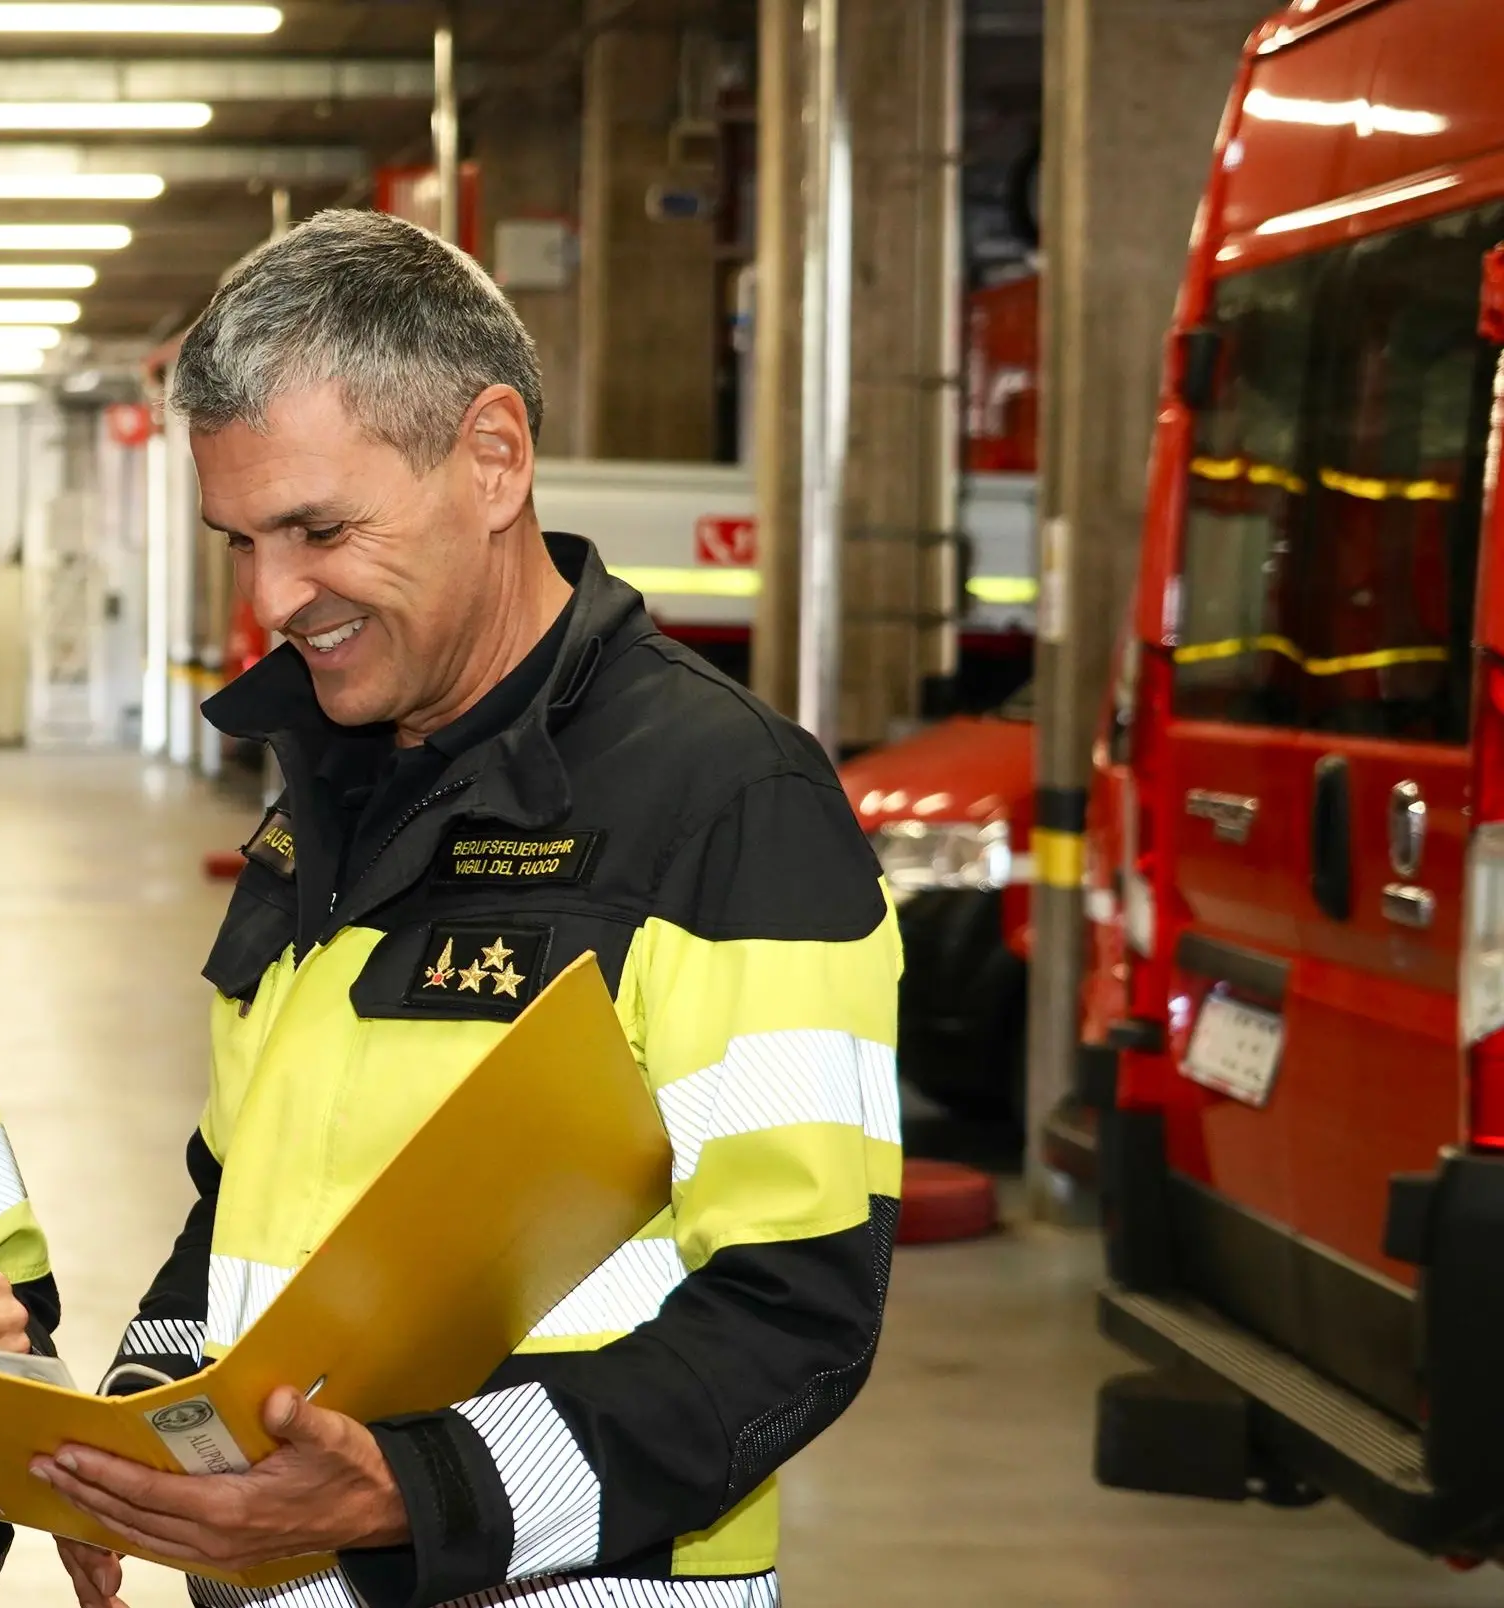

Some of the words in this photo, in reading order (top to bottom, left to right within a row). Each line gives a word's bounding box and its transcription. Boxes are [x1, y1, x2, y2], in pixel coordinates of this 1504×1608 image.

[452, 839, 574, 856] BERUFSFEUERWEHR
[456, 860, 487, 875] VIGILI
[488, 860, 514, 876] DEL
[518, 859, 560, 875] FUOCO
